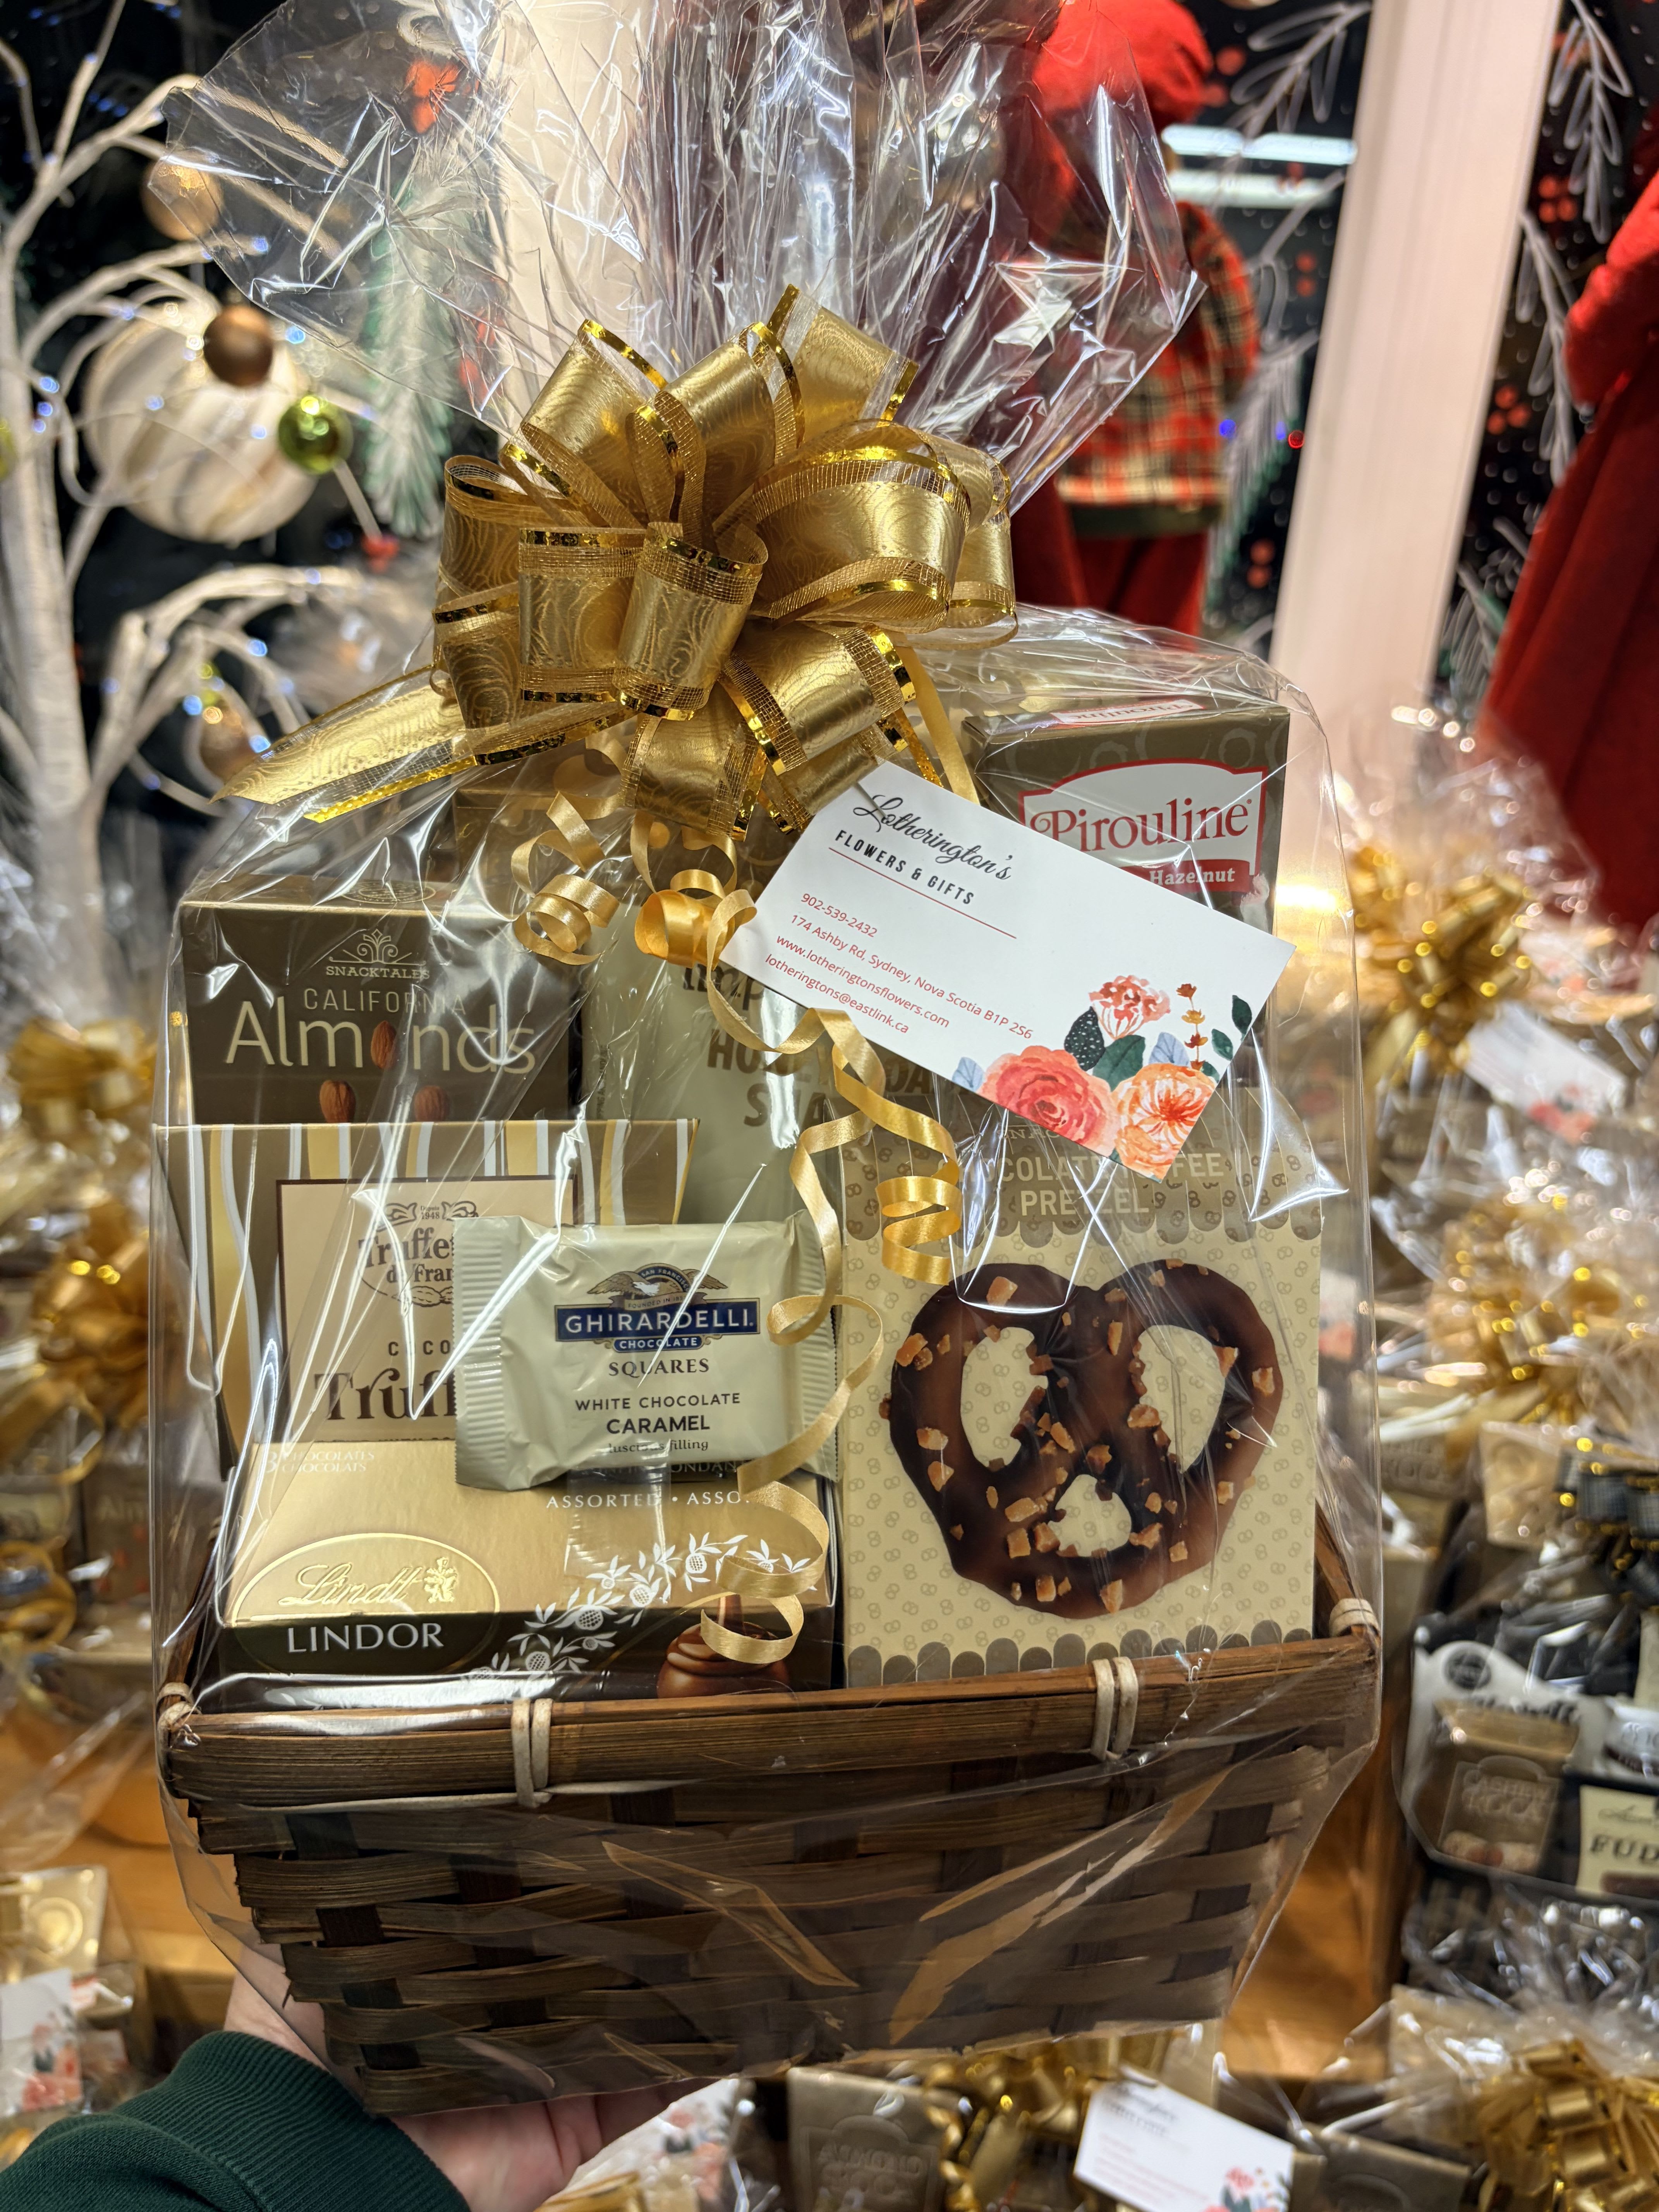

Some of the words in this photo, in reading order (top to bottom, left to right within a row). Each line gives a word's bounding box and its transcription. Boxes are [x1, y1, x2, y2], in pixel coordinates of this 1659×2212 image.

[853, 794, 1011, 881] Lotherington's
[835, 830, 907, 873] FLOWERS
[911, 867, 922, 880] &
[927, 876, 975, 905] GIFTS
[800, 893, 878, 938] 902-539-2432
[326, 965, 430, 981] SNACKTALES
[776, 935, 950, 1028] www.lotheringtonsflowers.com
[791, 914, 812, 932] 174
[812, 926, 848, 951] Ashby
[848, 944, 866, 961] Rd,
[868, 954, 912, 984] Sydney,
[914, 975, 945, 998] Nova
[946, 992, 982, 1016] Scotia
[983, 1010, 1009, 1027] B1P
[1009, 1021, 1034, 1040] 2S6
[304, 988, 466, 1015] CALIFORNIA
[765, 953, 910, 1034] lotheringtons@eastlink.ca
[641, 1269, 655, 1278] SAN
[565, 1309, 749, 1333] GHIRARDELLI
[620, 1337, 698, 1349] CHOCOLATE
[608, 1358, 709, 1378] SQUARES
[575, 1398, 631, 1412] WHITE
[640, 1393, 741, 1408] CHOCOLATE
[606, 1415, 710, 1435] CARAMEL
[546, 1492, 660, 1508] ASSORTED
[278, 1563, 423, 1607] Lindt
[288, 1623, 444, 1654] LINDOR
